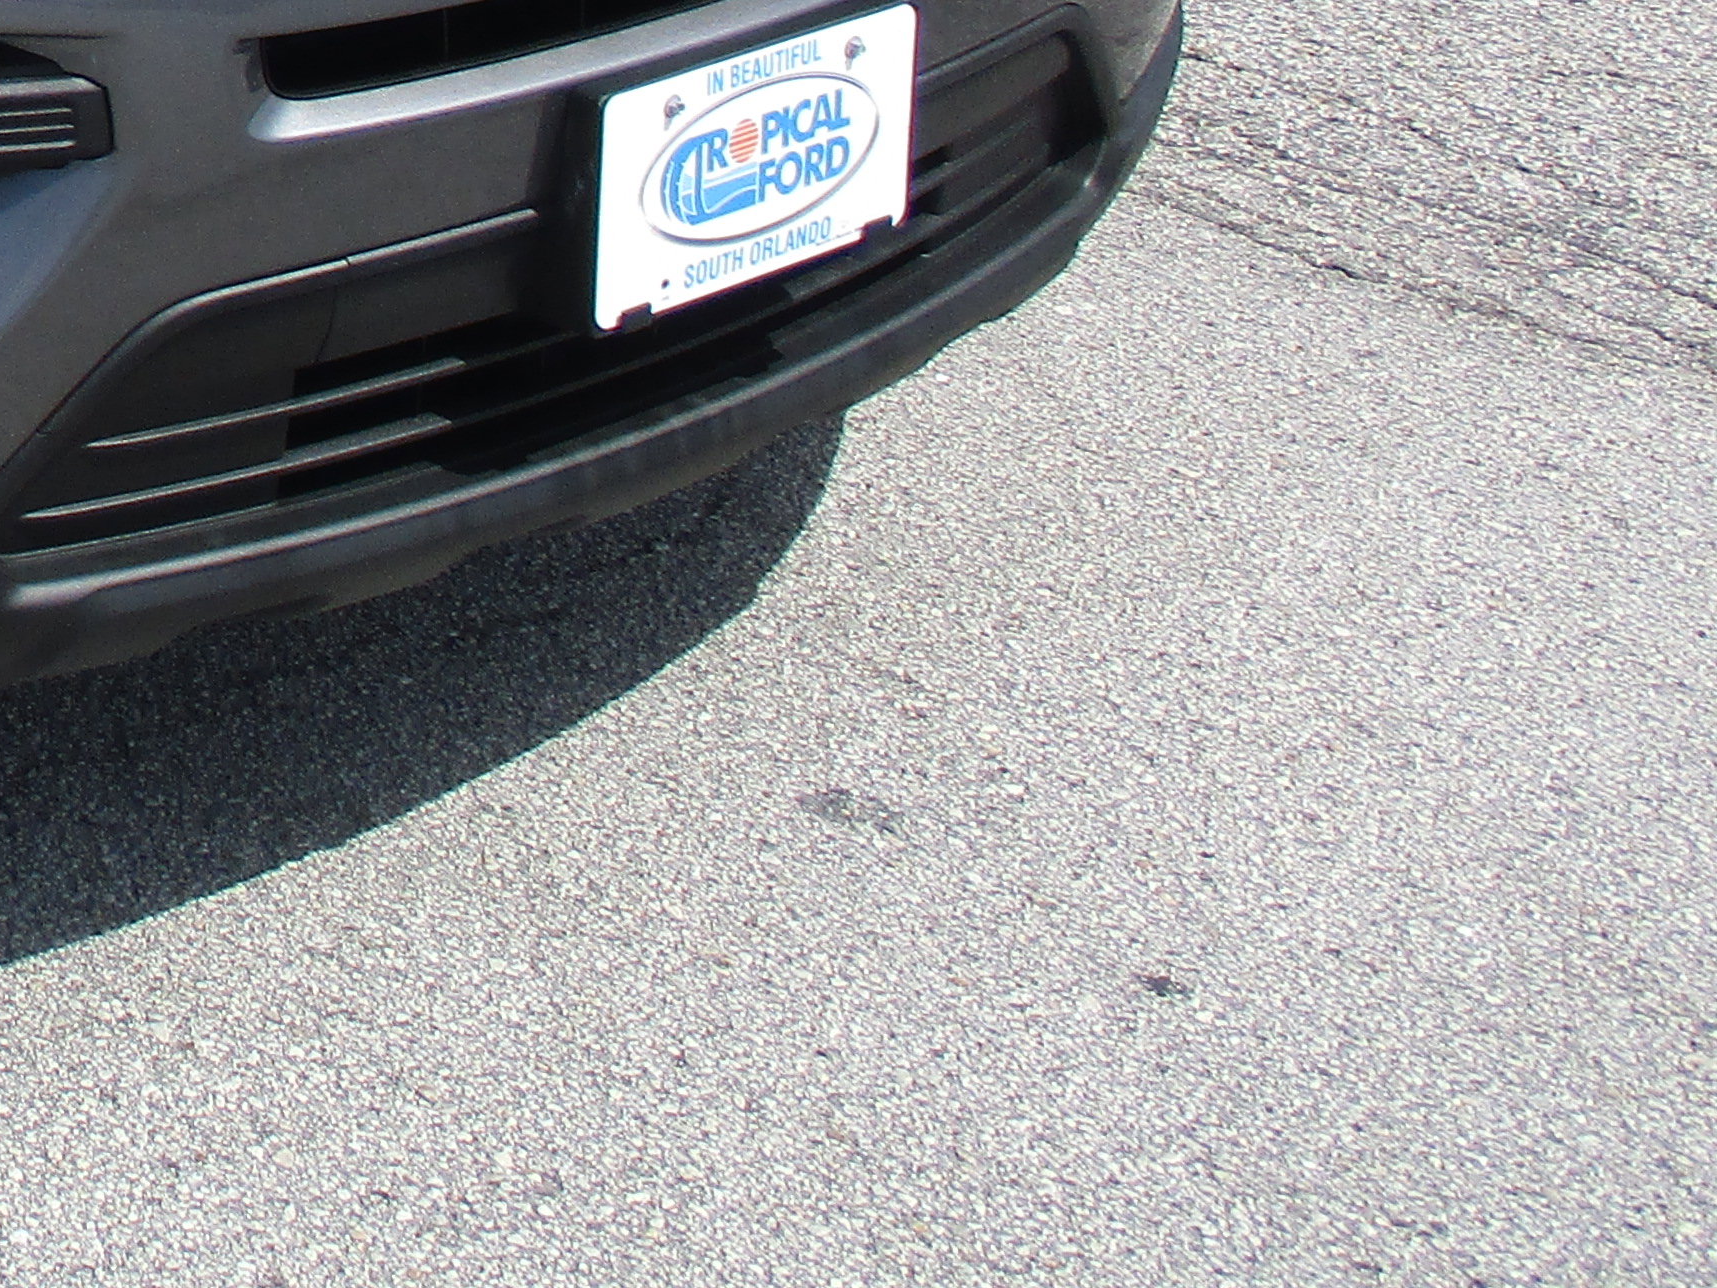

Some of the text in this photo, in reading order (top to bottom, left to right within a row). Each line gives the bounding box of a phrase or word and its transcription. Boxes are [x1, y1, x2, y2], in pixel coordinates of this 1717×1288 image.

[706, 38, 822, 96] IN BEAUTIFUL
[665, 87, 851, 216] TROPICAL
[756, 134, 851, 203] FORD
[683, 215, 833, 290] SOUTH ORLANDO
